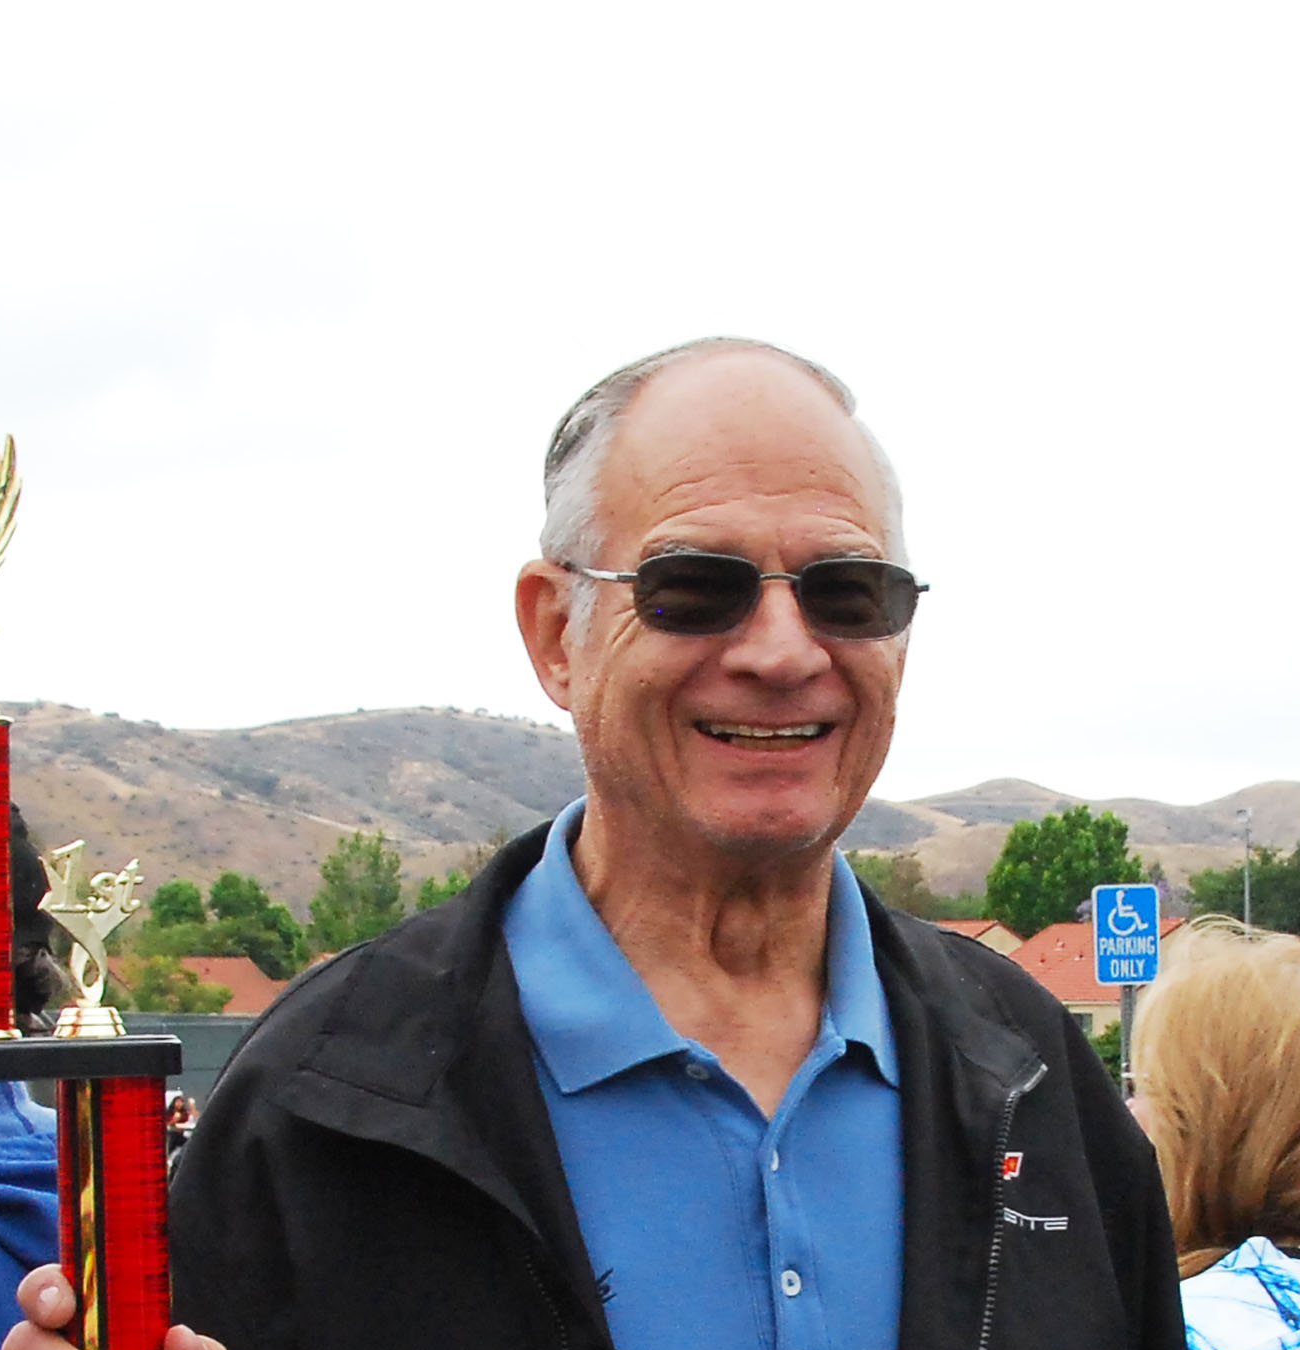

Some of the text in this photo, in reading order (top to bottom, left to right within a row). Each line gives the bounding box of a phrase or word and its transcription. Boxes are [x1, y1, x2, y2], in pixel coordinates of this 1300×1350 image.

[44, 839, 144, 913] 1st
[1099, 935, 1156, 955] PARKING
[1110, 959, 1146, 977] ONLY
